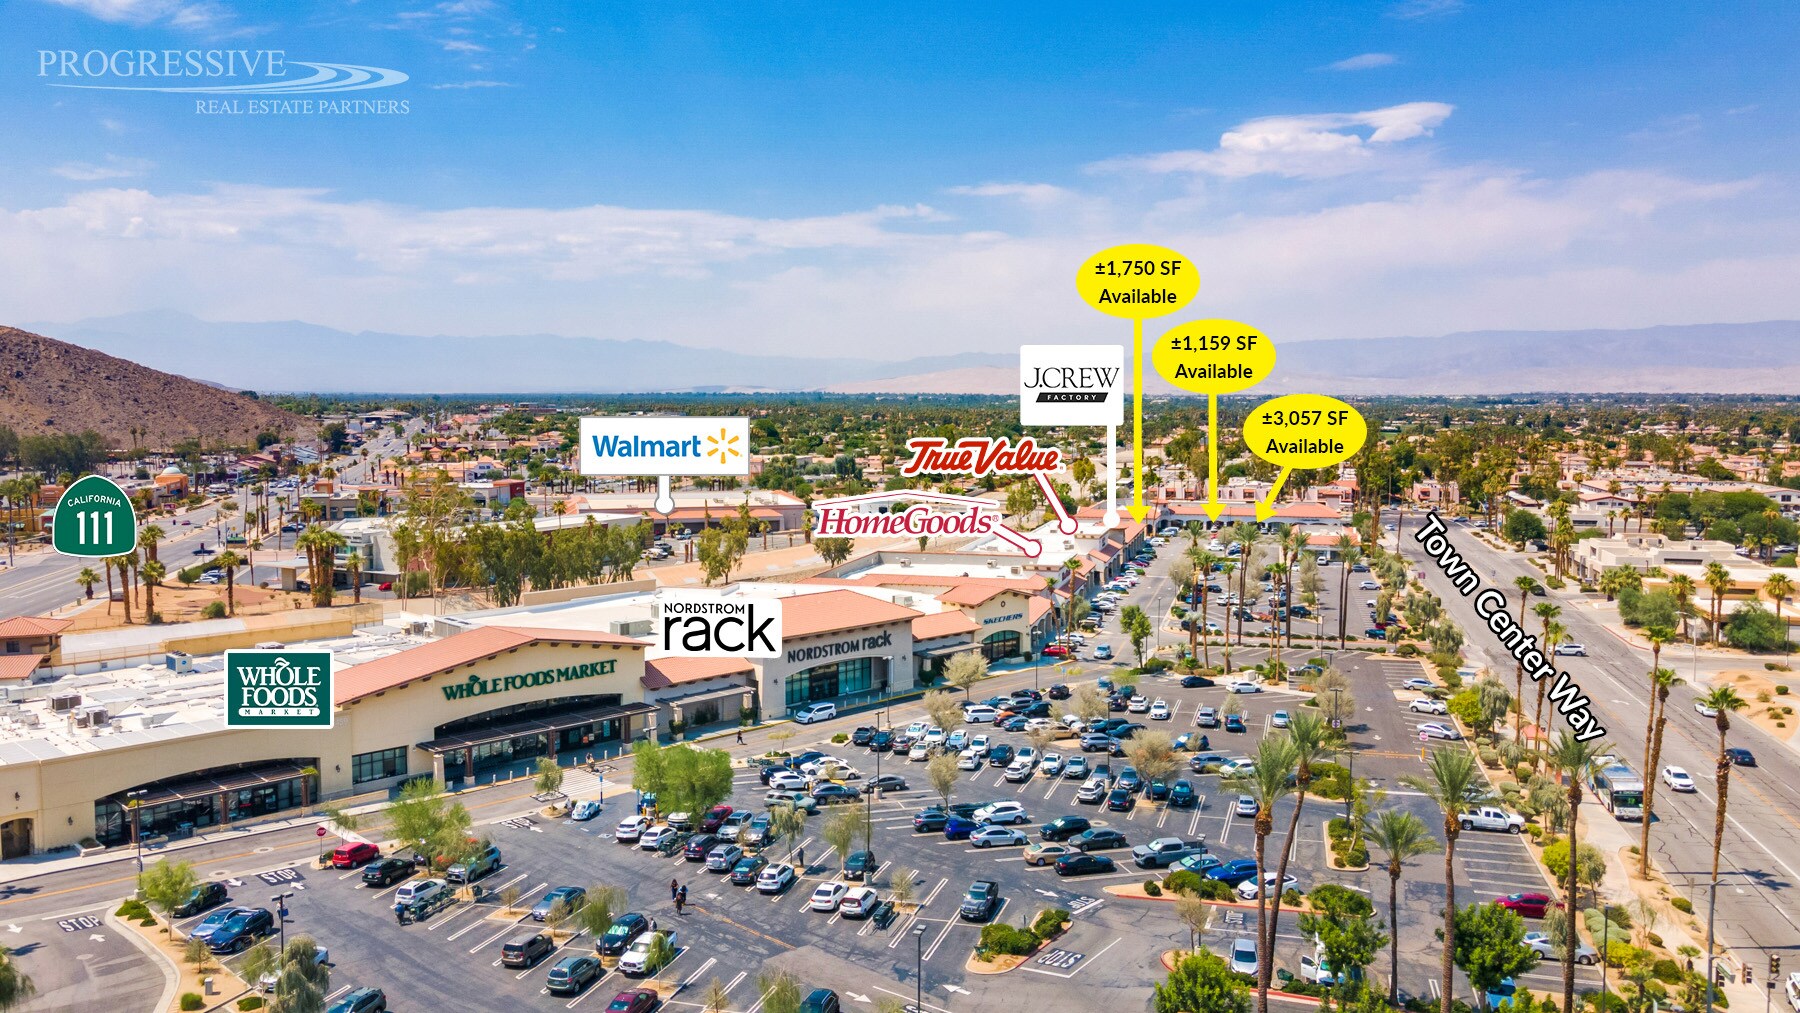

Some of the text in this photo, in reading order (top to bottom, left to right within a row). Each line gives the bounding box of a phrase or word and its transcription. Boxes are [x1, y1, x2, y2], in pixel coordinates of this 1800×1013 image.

[983, 613, 1023, 625] SKECHERS
[787, 630, 892, 664] NORDSTROM rack
[441, 659, 618, 701] WHOLE FOODS MARKET
[260, 868, 298, 883] STOP
[59, 915, 99, 932] STOP
[1037, 949, 1082, 968] STOP
